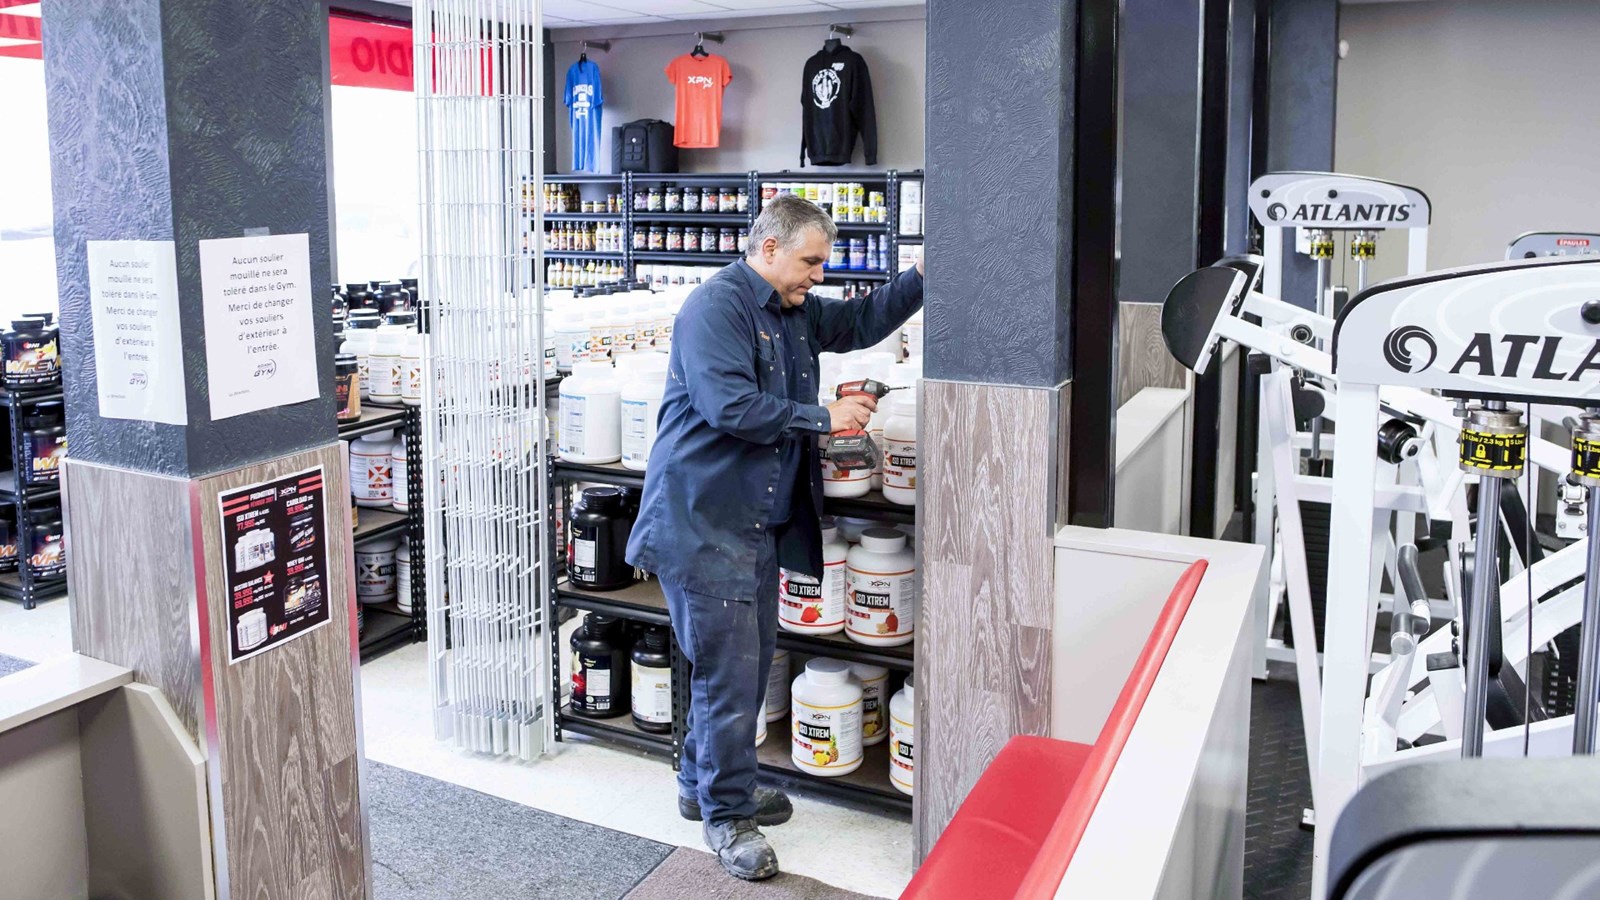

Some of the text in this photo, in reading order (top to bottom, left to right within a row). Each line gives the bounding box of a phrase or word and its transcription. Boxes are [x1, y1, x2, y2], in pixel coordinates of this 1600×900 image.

[688, 75, 712, 85] XPN
[1292, 204, 1411, 222] ATLANTIS
[109, 259, 130, 268] Aucun
[232, 253, 284, 265] Aucun soulier
[230, 270, 260, 280] mouillé
[272, 268, 288, 276] sera
[223, 281, 297, 296] toléré dans le Gym.
[106, 306, 126, 314] Merci
[127, 307, 135, 315] de
[228, 298, 294, 312] Merci de changer
[239, 313, 284, 326] vos souliers
[238, 326, 288, 341] d'extérieur à
[6, 357, 57, 374] WHEY
[253, 367, 274, 378] GYM
[1495, 439, 1504, 447] kg
[891, 457, 899, 465] ISO
[280, 486, 297, 496] XPN
[788, 583, 821, 596] ISO XTREM
[855, 593, 889, 606] ISO XTREM
[863, 699, 878, 710] TREM
[799, 725, 830, 739] ISO XTREM
[900, 745, 909, 755] ISO
